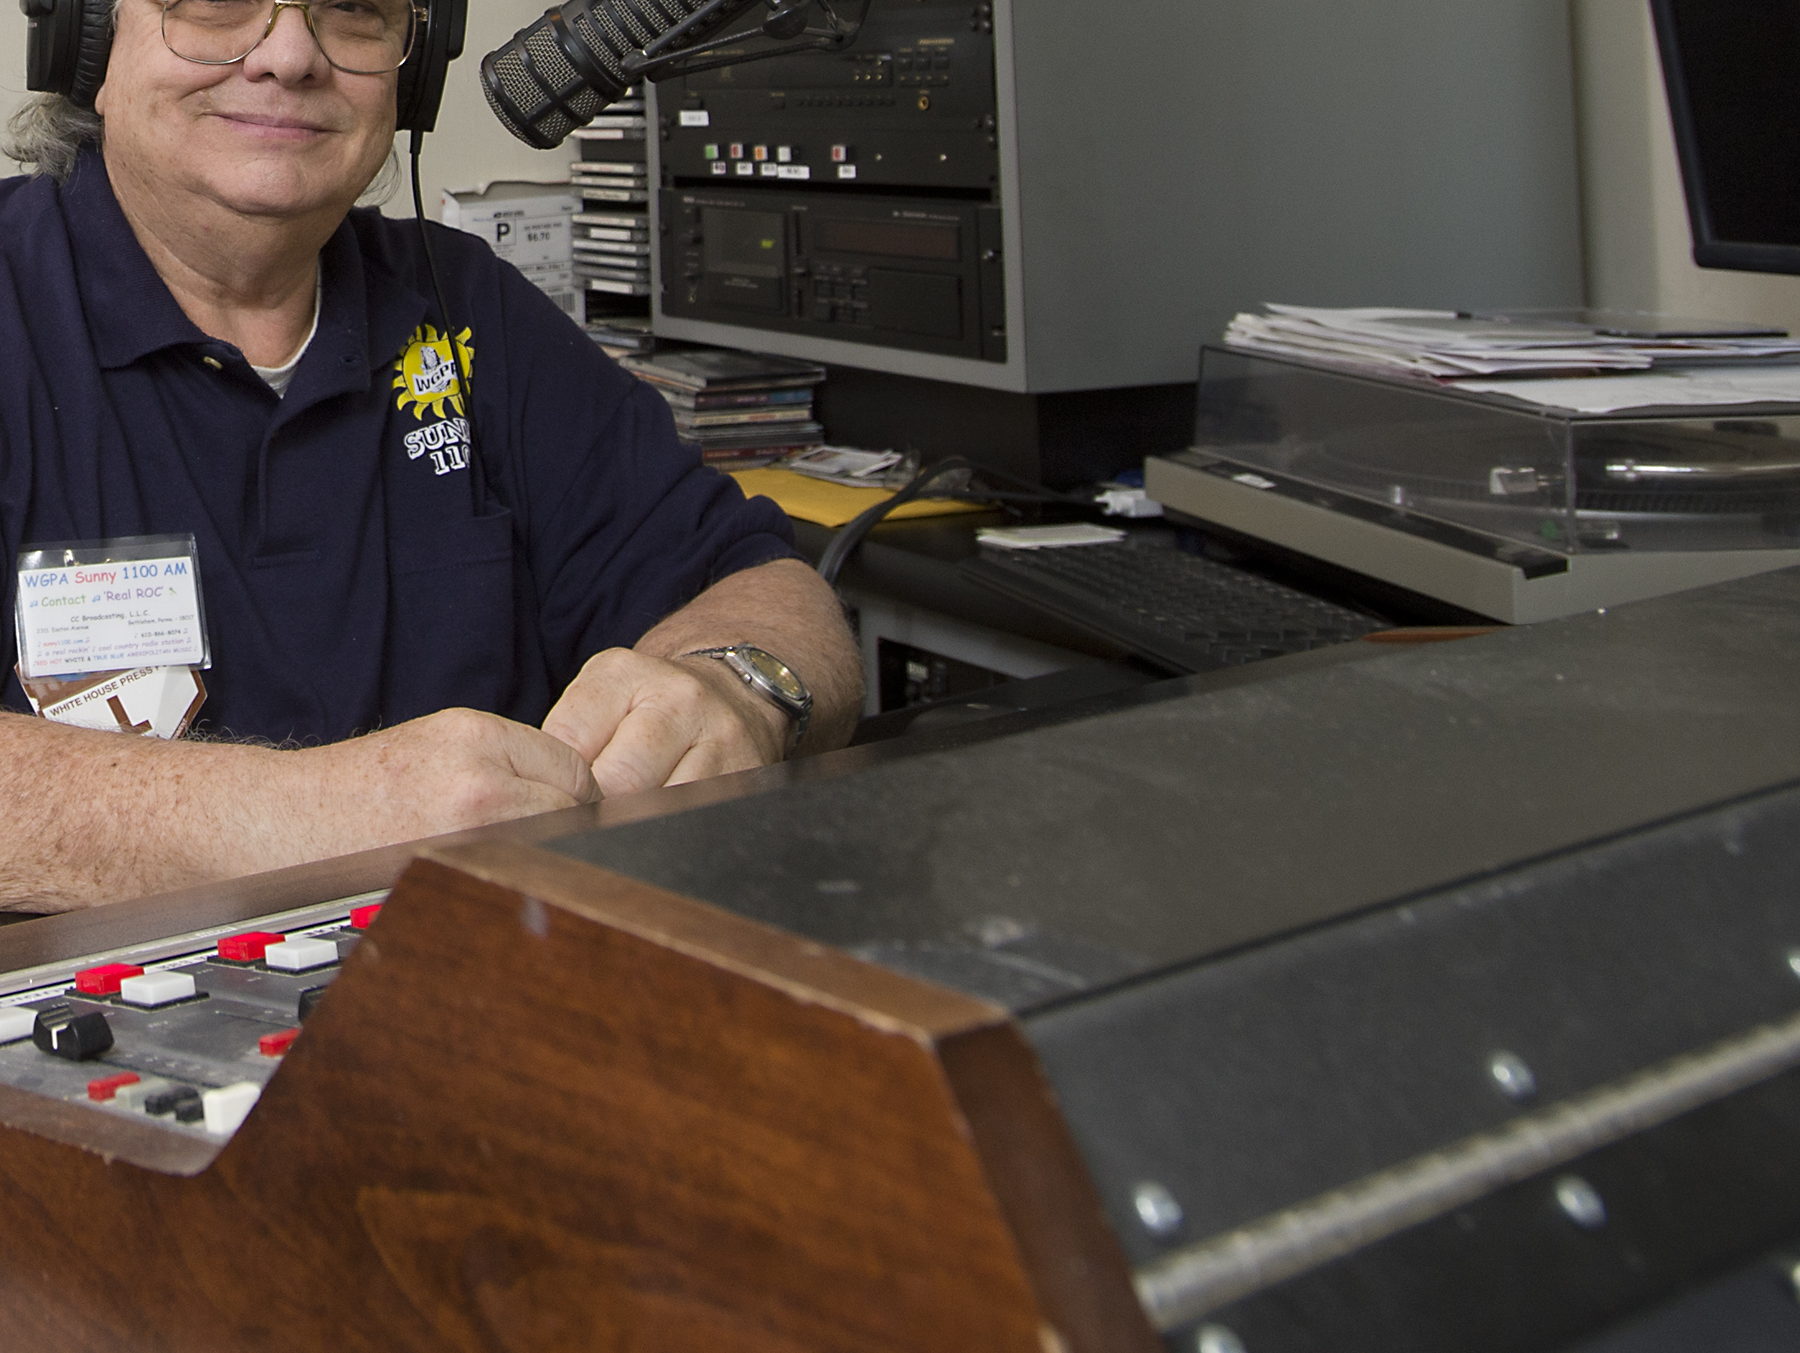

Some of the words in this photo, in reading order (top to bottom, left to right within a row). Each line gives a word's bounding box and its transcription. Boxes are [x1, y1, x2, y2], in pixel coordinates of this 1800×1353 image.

[497, 222, 511, 242] P
[24, 573, 69, 588] WGPA
[75, 571, 117, 585] Sunny
[122, 564, 158, 580] 1100
[164, 562, 188, 576] AM
[41, 595, 87, 607] Contact
[141, 639, 159, 647] radio
[161, 638, 184, 646] station
[110, 652, 124, 660] BLUE
[50, 697, 83, 717] WHITE
[83, 681, 119, 702] HOUSE
[121, 665, 154, 686] PRESS
